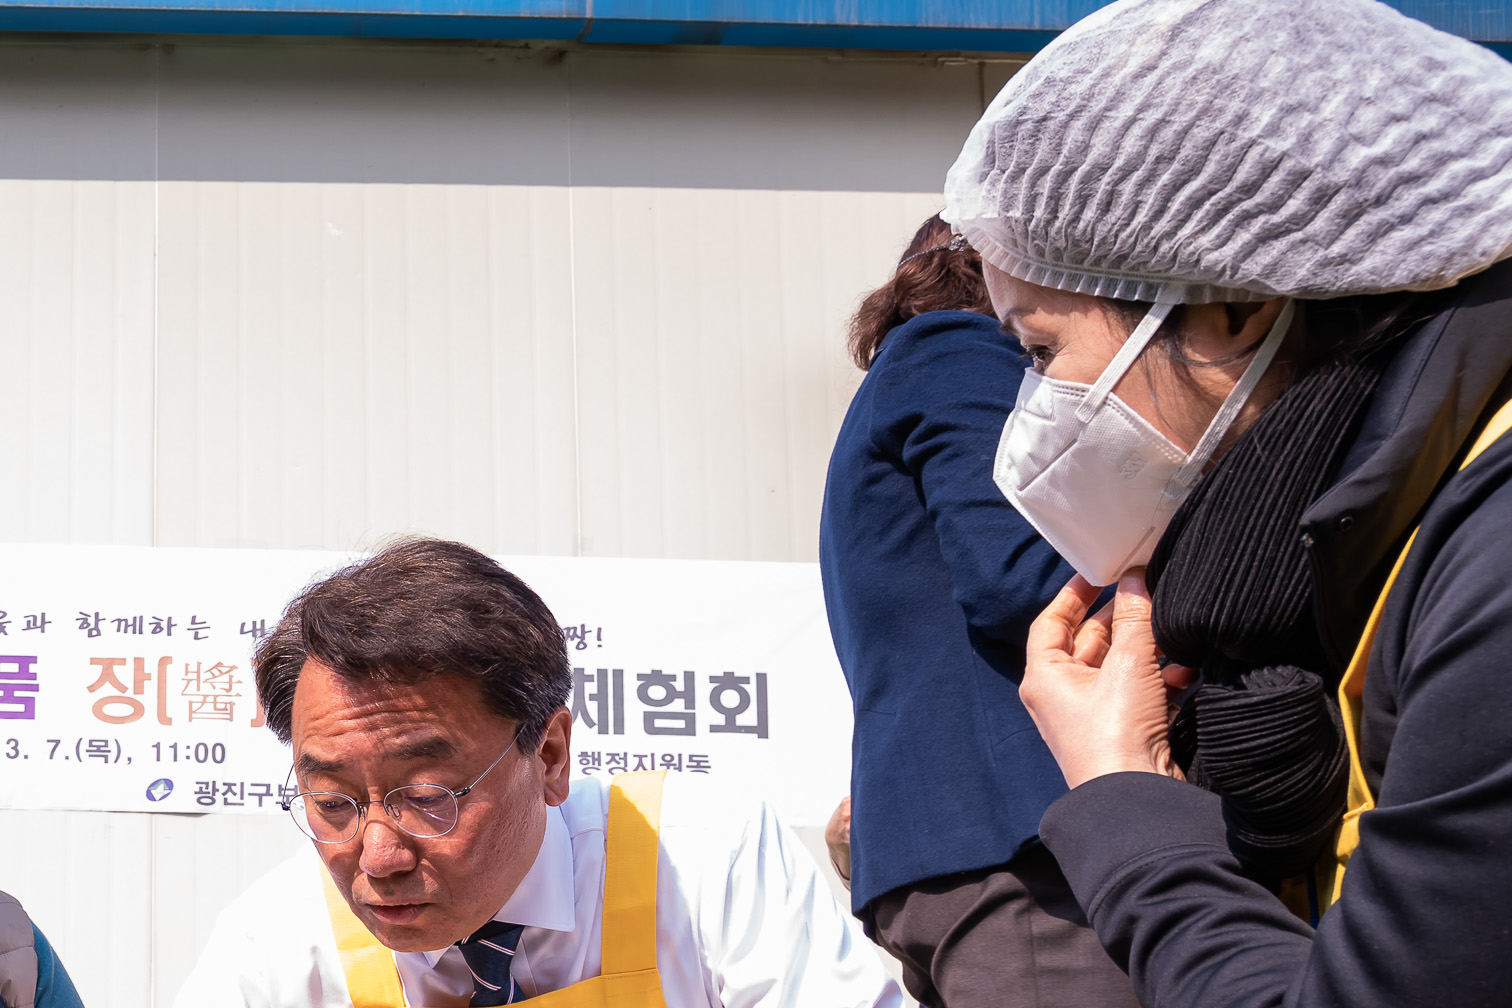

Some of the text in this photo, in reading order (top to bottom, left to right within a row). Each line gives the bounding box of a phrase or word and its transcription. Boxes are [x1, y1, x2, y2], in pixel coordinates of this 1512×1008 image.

[75, 611, 211, 641] 함께하는
[571, 667, 769, 739] 체험회
[5, 738, 29, 760] 3.
[151, 741, 227, 764] 11:00
